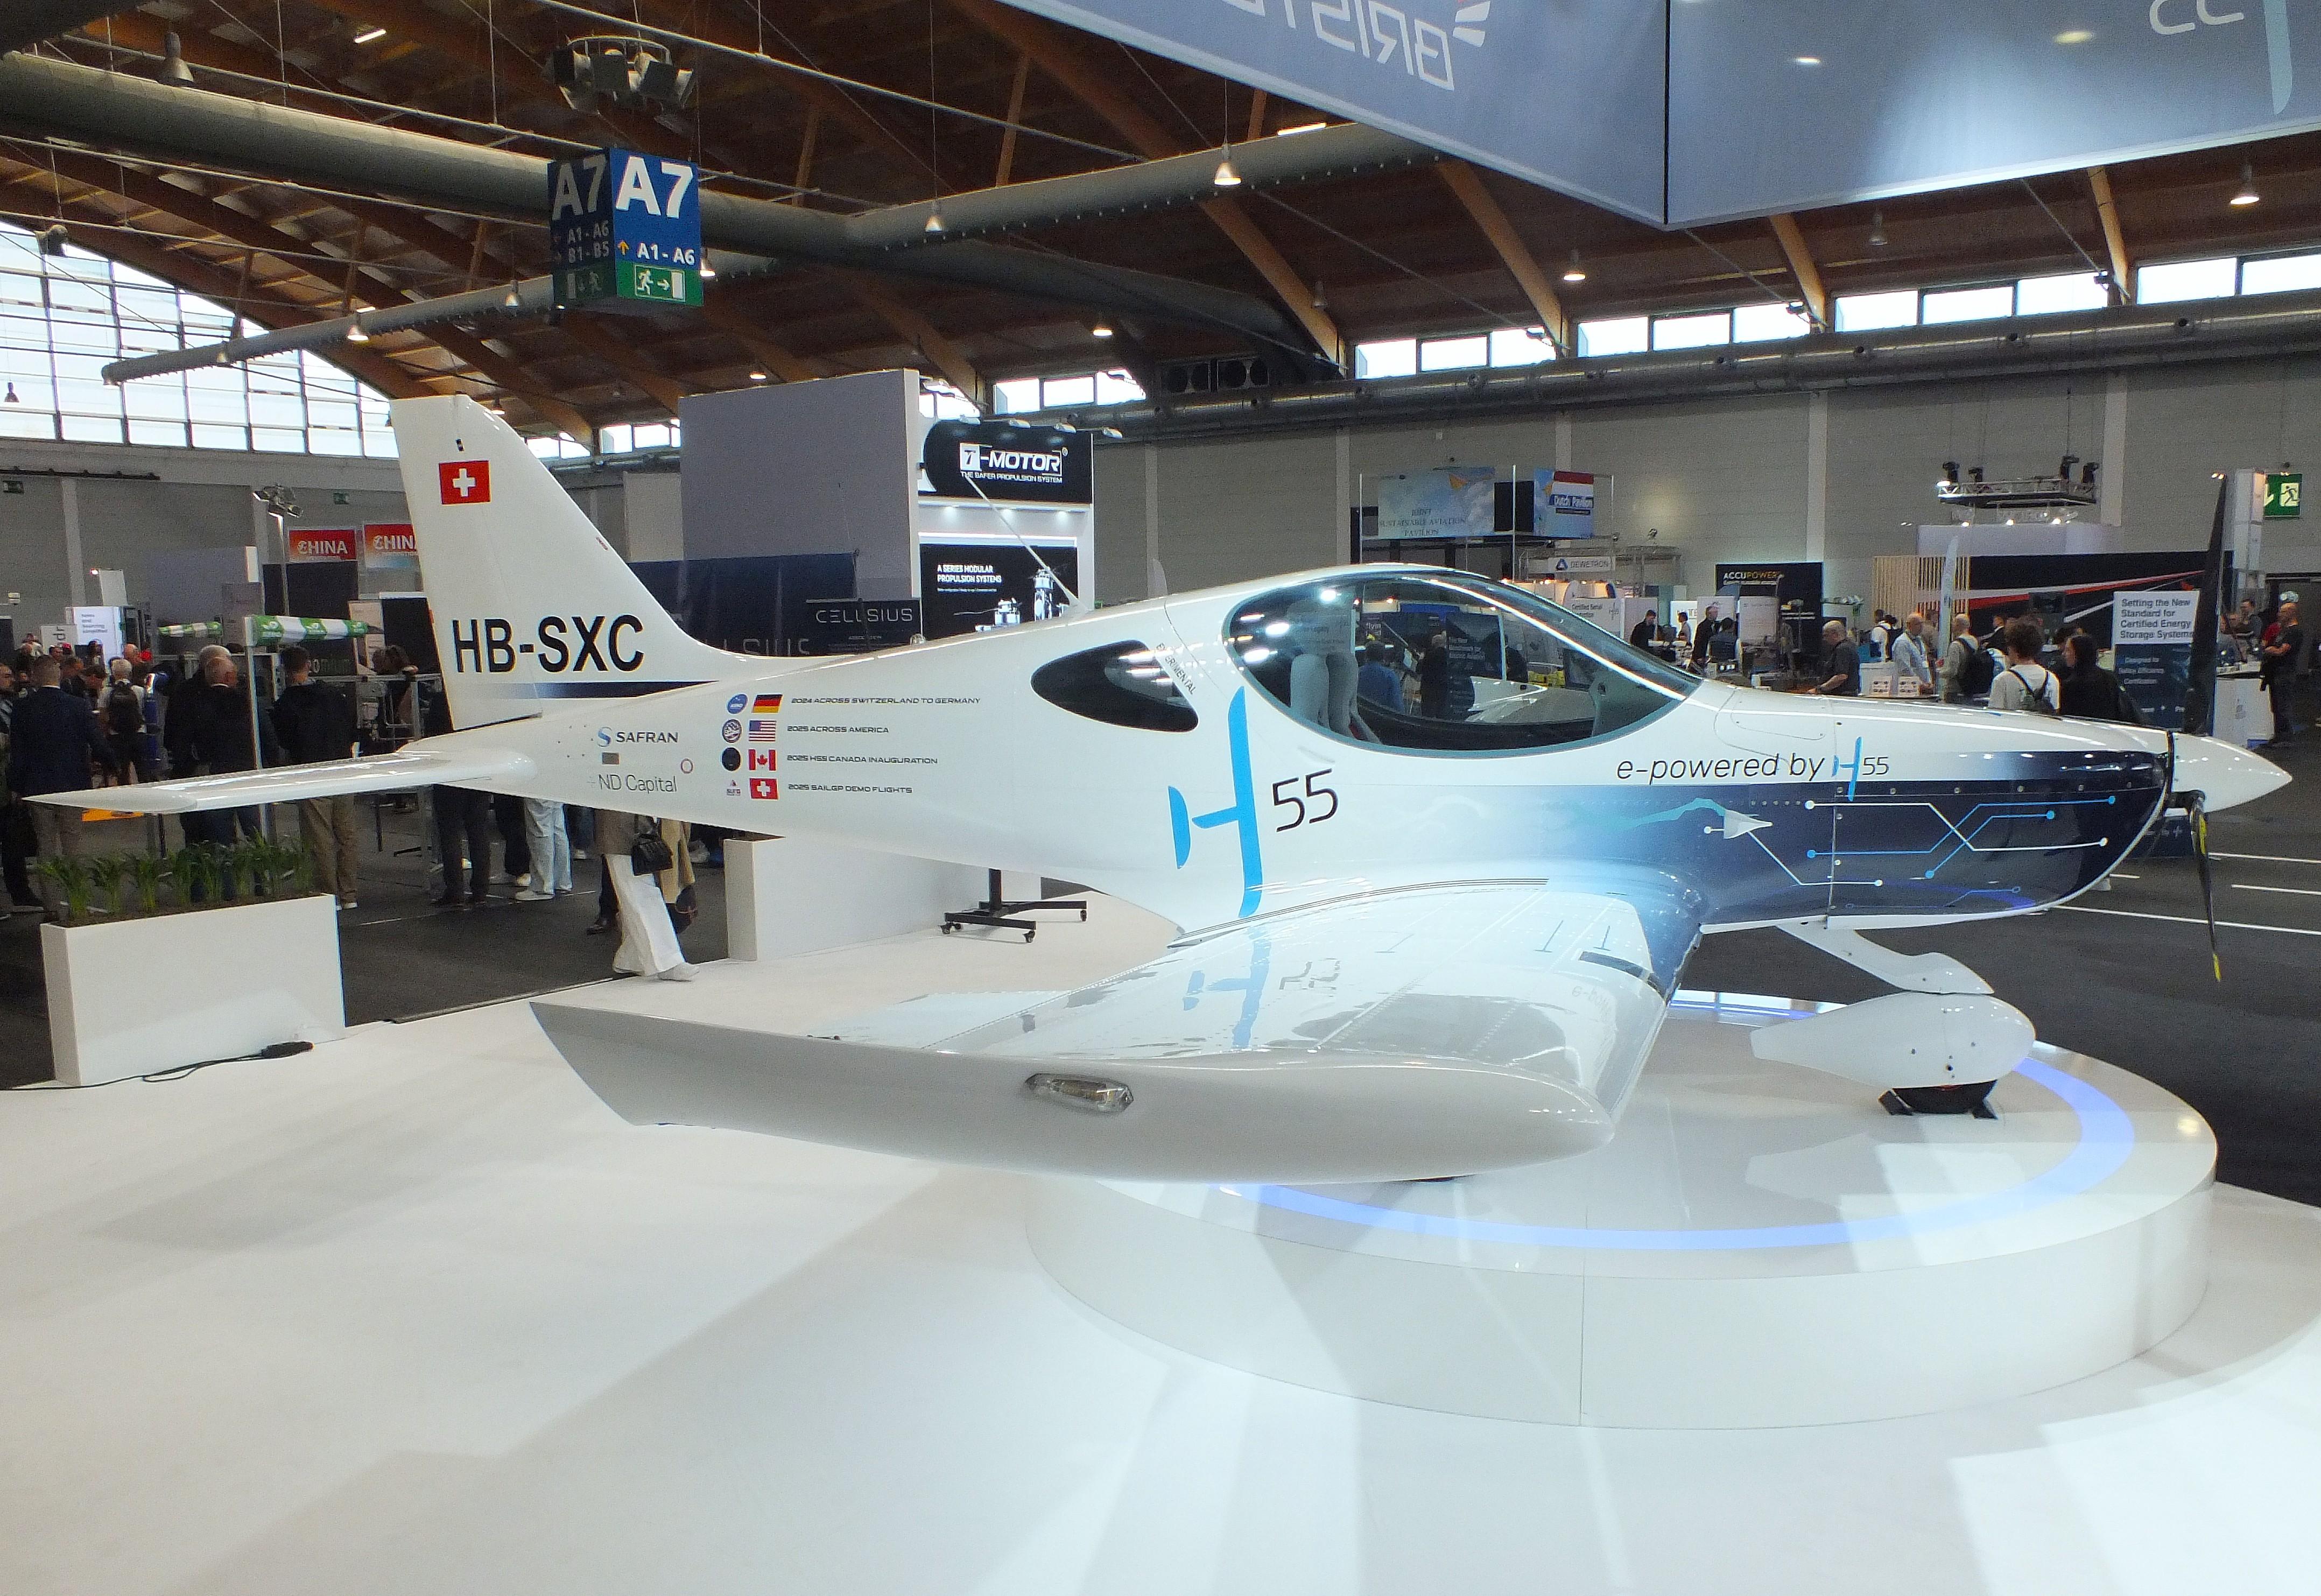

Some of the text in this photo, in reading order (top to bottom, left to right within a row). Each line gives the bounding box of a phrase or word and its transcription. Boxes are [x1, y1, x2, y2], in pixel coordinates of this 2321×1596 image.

[553, 154, 608, 221] A7
[616, 156, 694, 219] A7
[568, 227, 582, 245] A1
[593, 220, 609, 238] A6
[568, 247, 582, 263] B1
[593, 240, 609, 257] B5
[637, 242, 659, 261] A1
[673, 248, 695, 265] A6
[975, 472, 995, 480] SAFER
[996, 473, 1036, 482] PROPULSION
[1037, 475, 1063, 483] SYSTEM
[1429, 517, 1466, 526] AVIATION
[1404, 529, 1439, 537] PAVILION
[298, 540, 348, 555] CHINA
[372, 535, 417, 550] CHIN
[937, 564, 994, 573] A SERIES MODULAR
[937, 574, 1002, 583] PROPULSION SYSTEMS
[2121, 598, 2153, 608] Setting
[2155, 599, 2169, 607] the
[815, 607, 914, 624] CELLSIUS
[2121, 609, 2176, 617] Standard for
[2120, 619, 2191, 630] Certified Energy
[2120, 630, 2154, 641] Storage
[452, 614, 645, 673] HB-SXC
[616, 732, 679, 743] SAFRAN
[1616, 753, 1780, 785] e-powered
[1789, 752, 1825, 782] by
[598, 774, 678, 794] ND Capital
